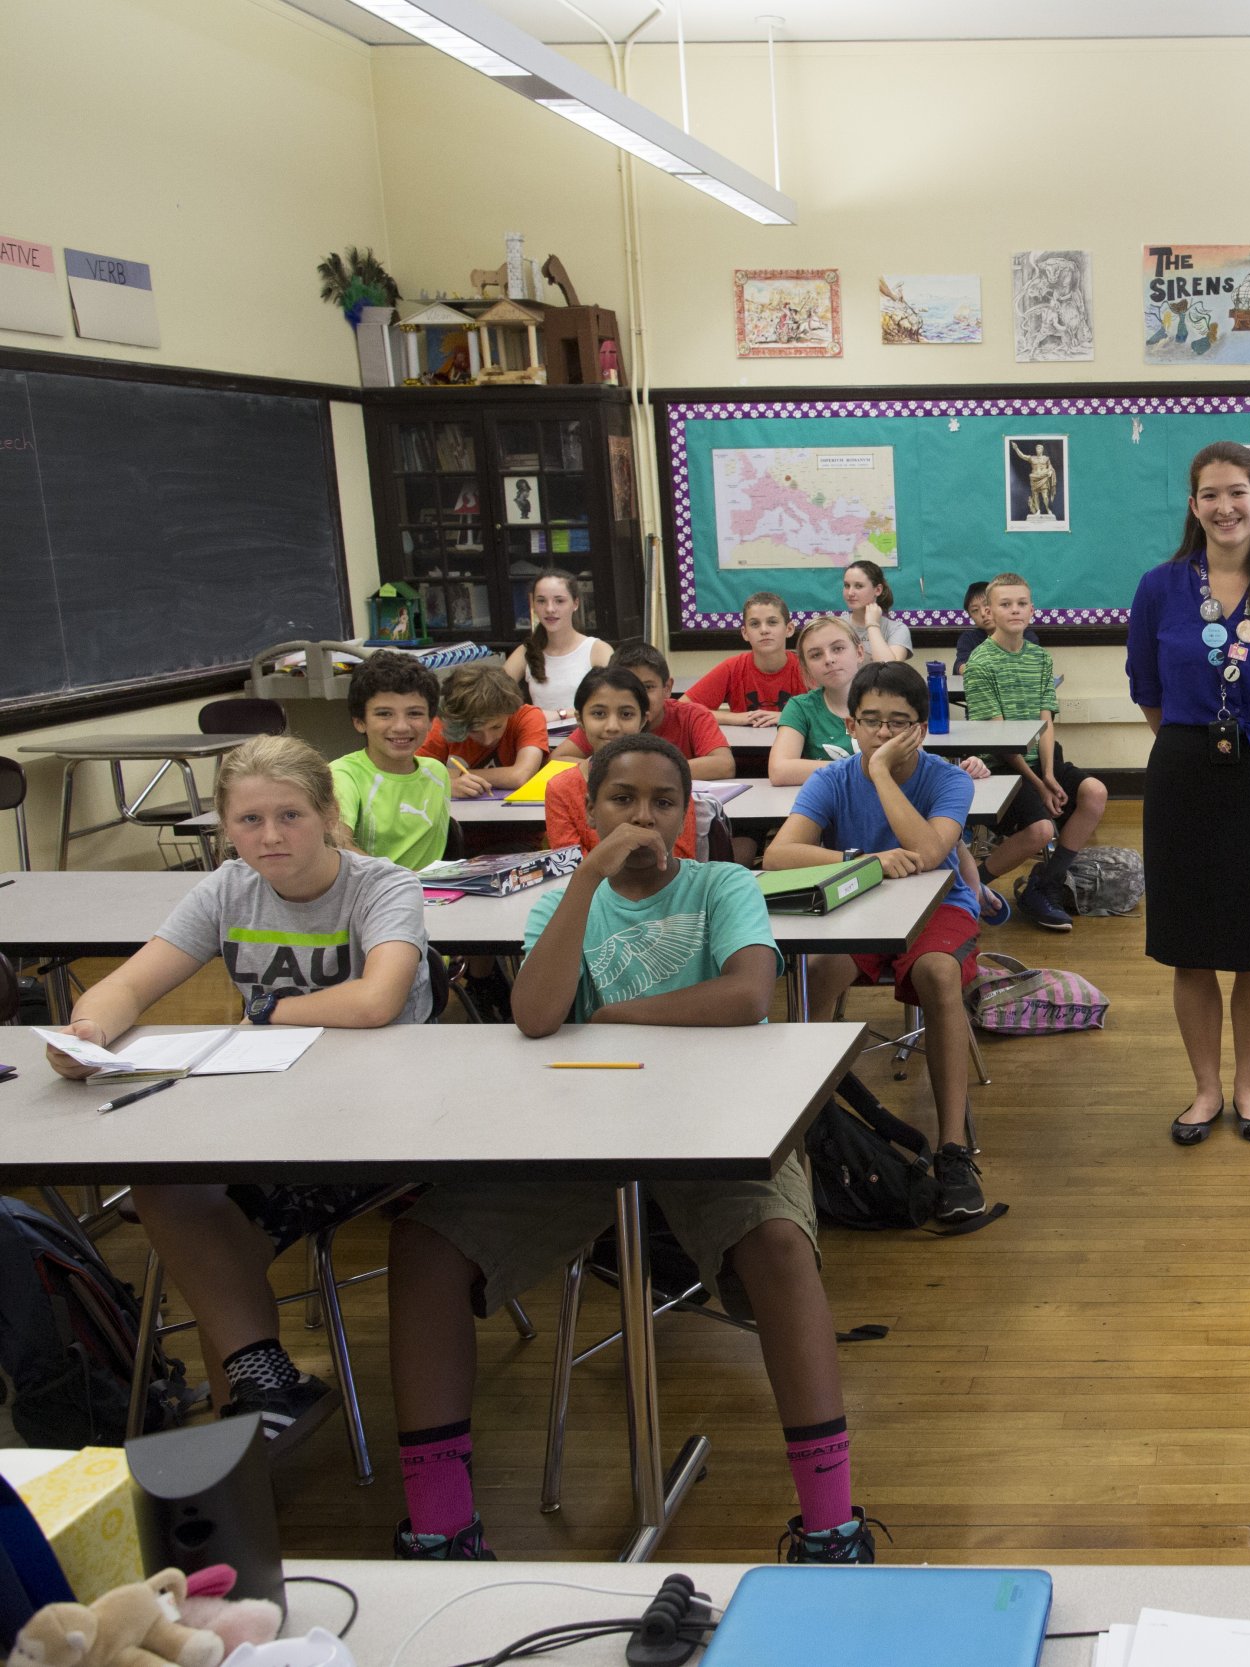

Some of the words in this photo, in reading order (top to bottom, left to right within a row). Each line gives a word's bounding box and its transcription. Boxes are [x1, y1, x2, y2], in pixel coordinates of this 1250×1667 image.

[86, 258, 127, 285] VERB
[1149, 247, 1194, 278] THE
[1149, 277, 1235, 303] SIRENS
[223, 941, 351, 986] LAU
